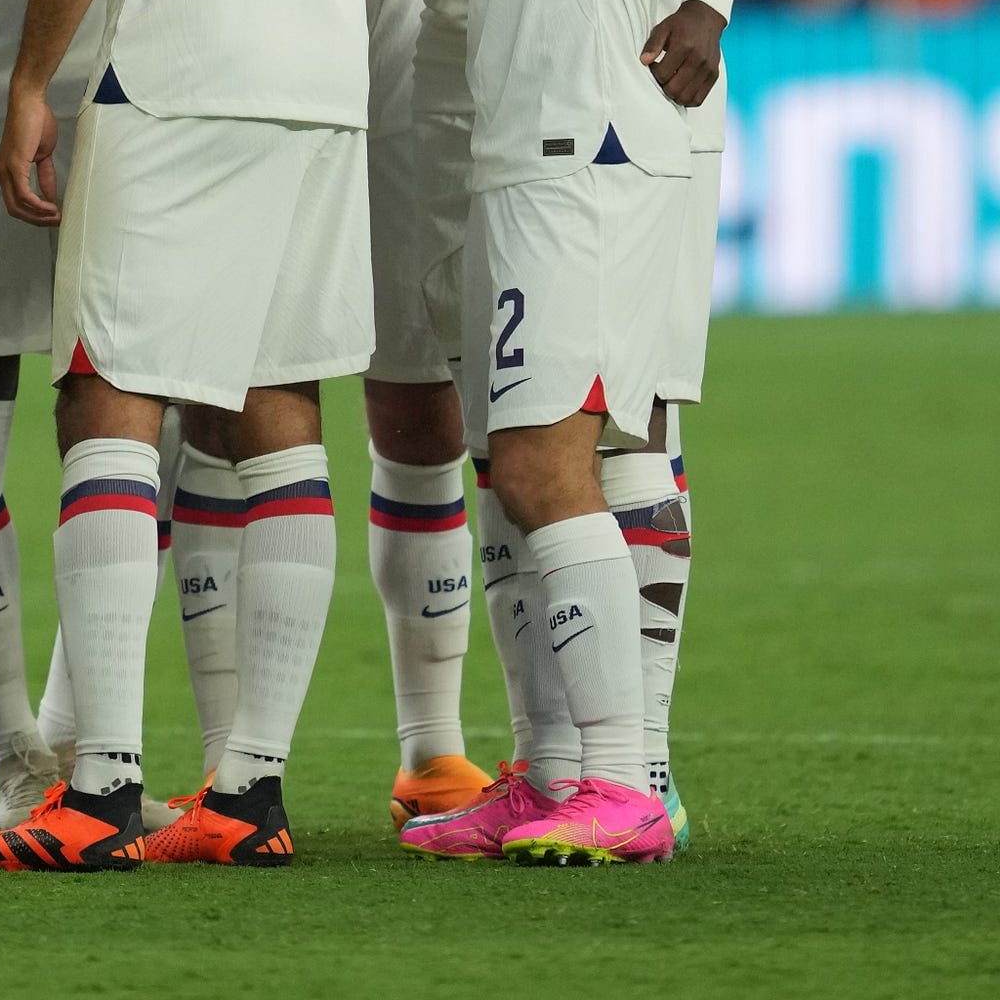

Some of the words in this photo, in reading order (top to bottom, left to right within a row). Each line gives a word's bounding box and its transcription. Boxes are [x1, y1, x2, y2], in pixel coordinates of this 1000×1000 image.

[495, 287, 525, 370] 2
[480, 544, 513, 563] USA
[180, 576, 218, 595] USA
[428, 575, 468, 594] USA
[550, 604, 583, 631] USA
